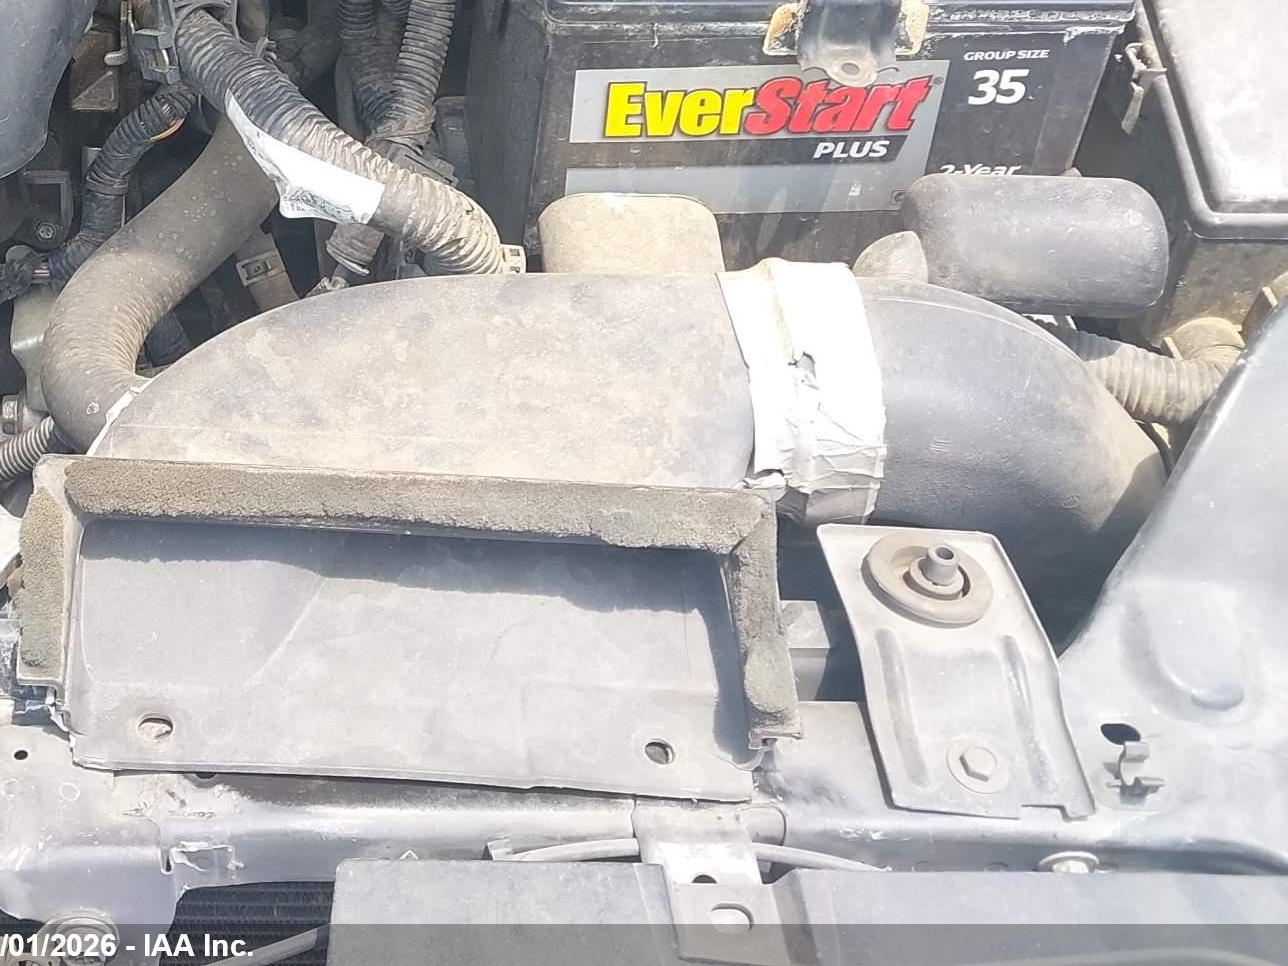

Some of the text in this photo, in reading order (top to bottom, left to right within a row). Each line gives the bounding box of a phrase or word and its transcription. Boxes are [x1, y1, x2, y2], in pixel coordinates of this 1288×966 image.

[964, 49, 1050, 61] GROUP SIZE
[968, 69, 1030, 105] 35
[604, 75, 933, 138] EverStart
[813, 140, 890, 159] PLUS
